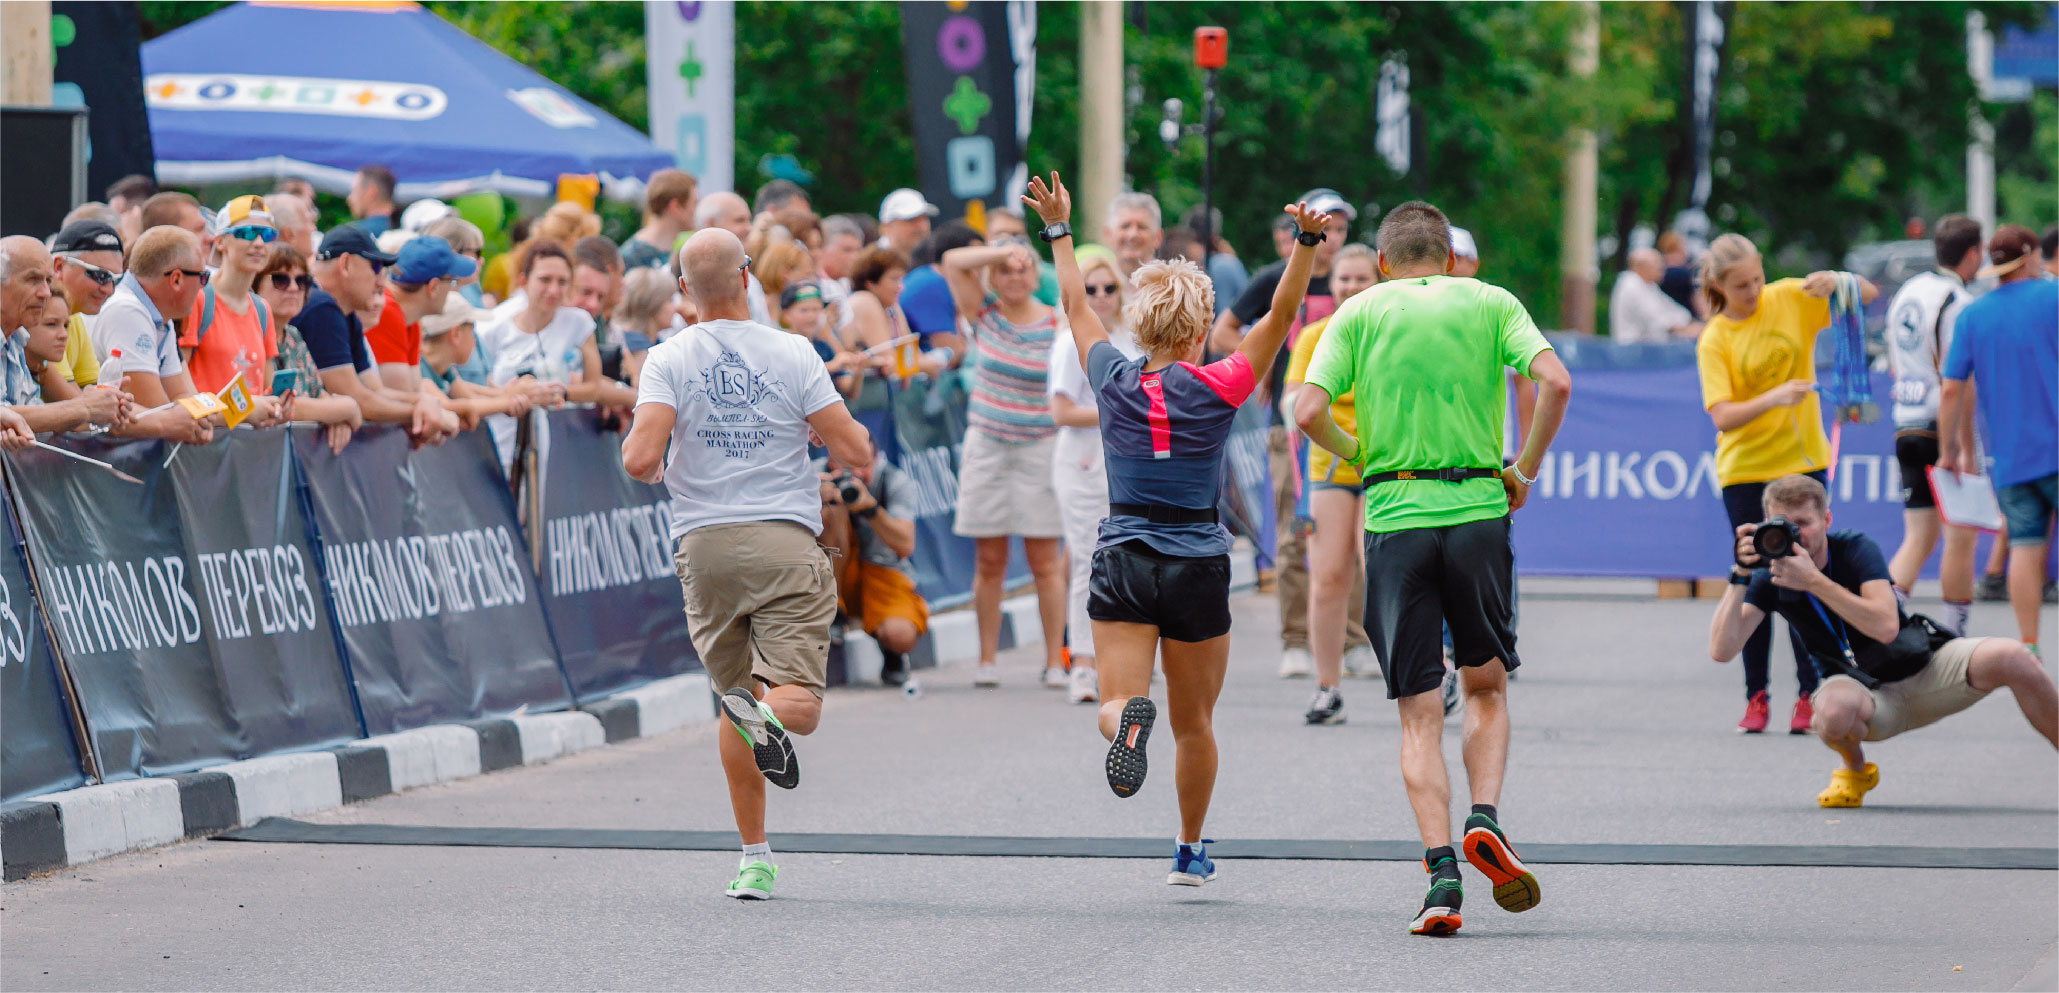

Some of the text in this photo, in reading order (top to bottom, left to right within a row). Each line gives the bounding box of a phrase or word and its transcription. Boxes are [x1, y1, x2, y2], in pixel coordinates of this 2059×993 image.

[720, 370, 745, 395] BS
[697, 429, 775, 440] CROSS RACING
[706, 440, 766, 449] MARATHON
[725, 449, 749, 459] 2017
[324, 524, 526, 627] НИКОЛОВ ПЕРЕВОЗ
[45, 543, 316, 656] НИКОЛОВ ПЕРЕВОЗ
